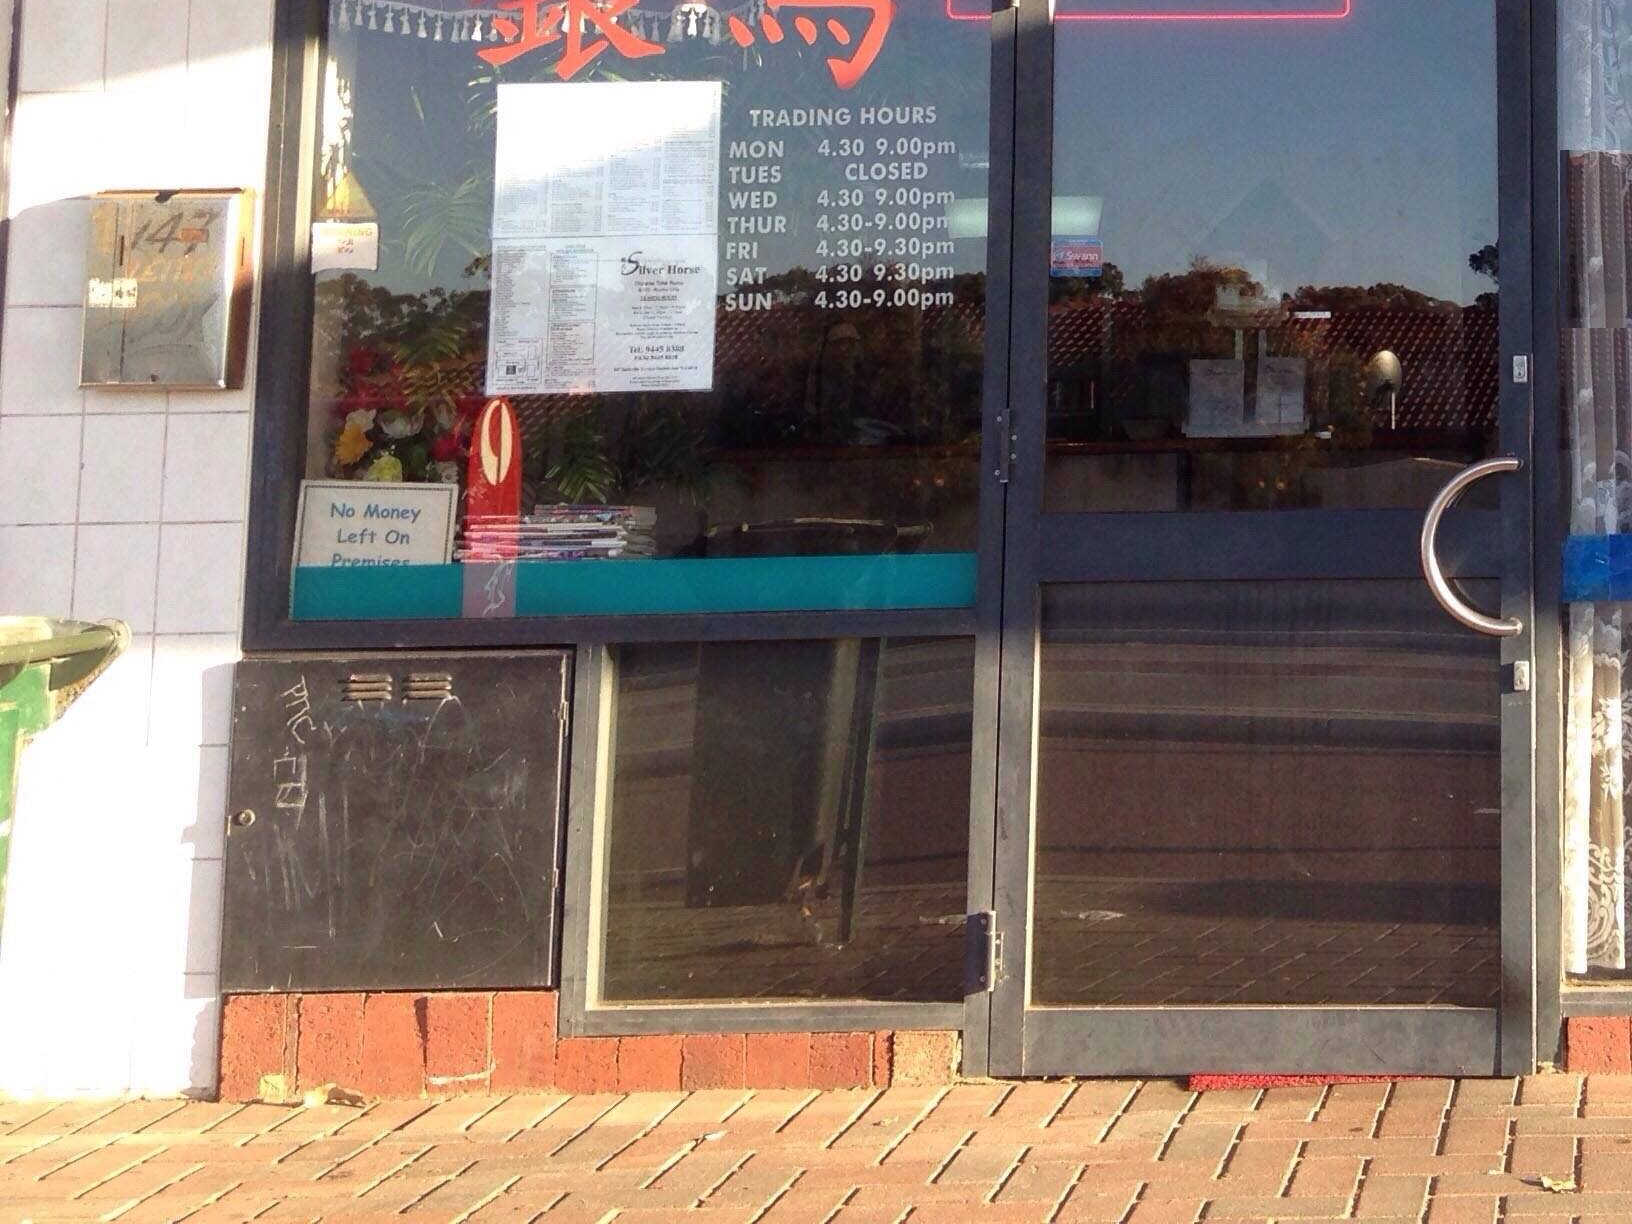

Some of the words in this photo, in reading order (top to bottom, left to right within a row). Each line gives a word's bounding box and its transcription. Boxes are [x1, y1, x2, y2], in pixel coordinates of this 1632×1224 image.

[750, 107, 850, 126] TRADING
[860, 106, 937, 124] HOURS
[729, 141, 784, 158] MON
[818, 139, 864, 156] 4.30
[876, 137, 956, 157] 9.00pm
[729, 166, 781, 183] TUES
[845, 162, 928, 180] CLOSED
[728, 191, 777, 208] WED
[817, 189, 863, 206] 4.30
[875, 187, 955, 208] 9.00pm
[728, 216, 786, 233] THUR
[816, 212, 952, 234] 4.30-9.00pm
[726, 242, 758, 259] FRI
[815, 238, 954, 259] 4.30-9.30pm
[726, 267, 767, 285] SAT
[815, 264, 862, 282] 4.30
[874, 263, 954, 283] 9.30pm
[725, 292, 772, 310] SUN
[814, 289, 954, 310] 4.30-9.00pm
[330, 502, 355, 518] No
[363, 504, 421, 523] Money
[337, 528, 376, 544] Left
[385, 530, 410, 545] On
